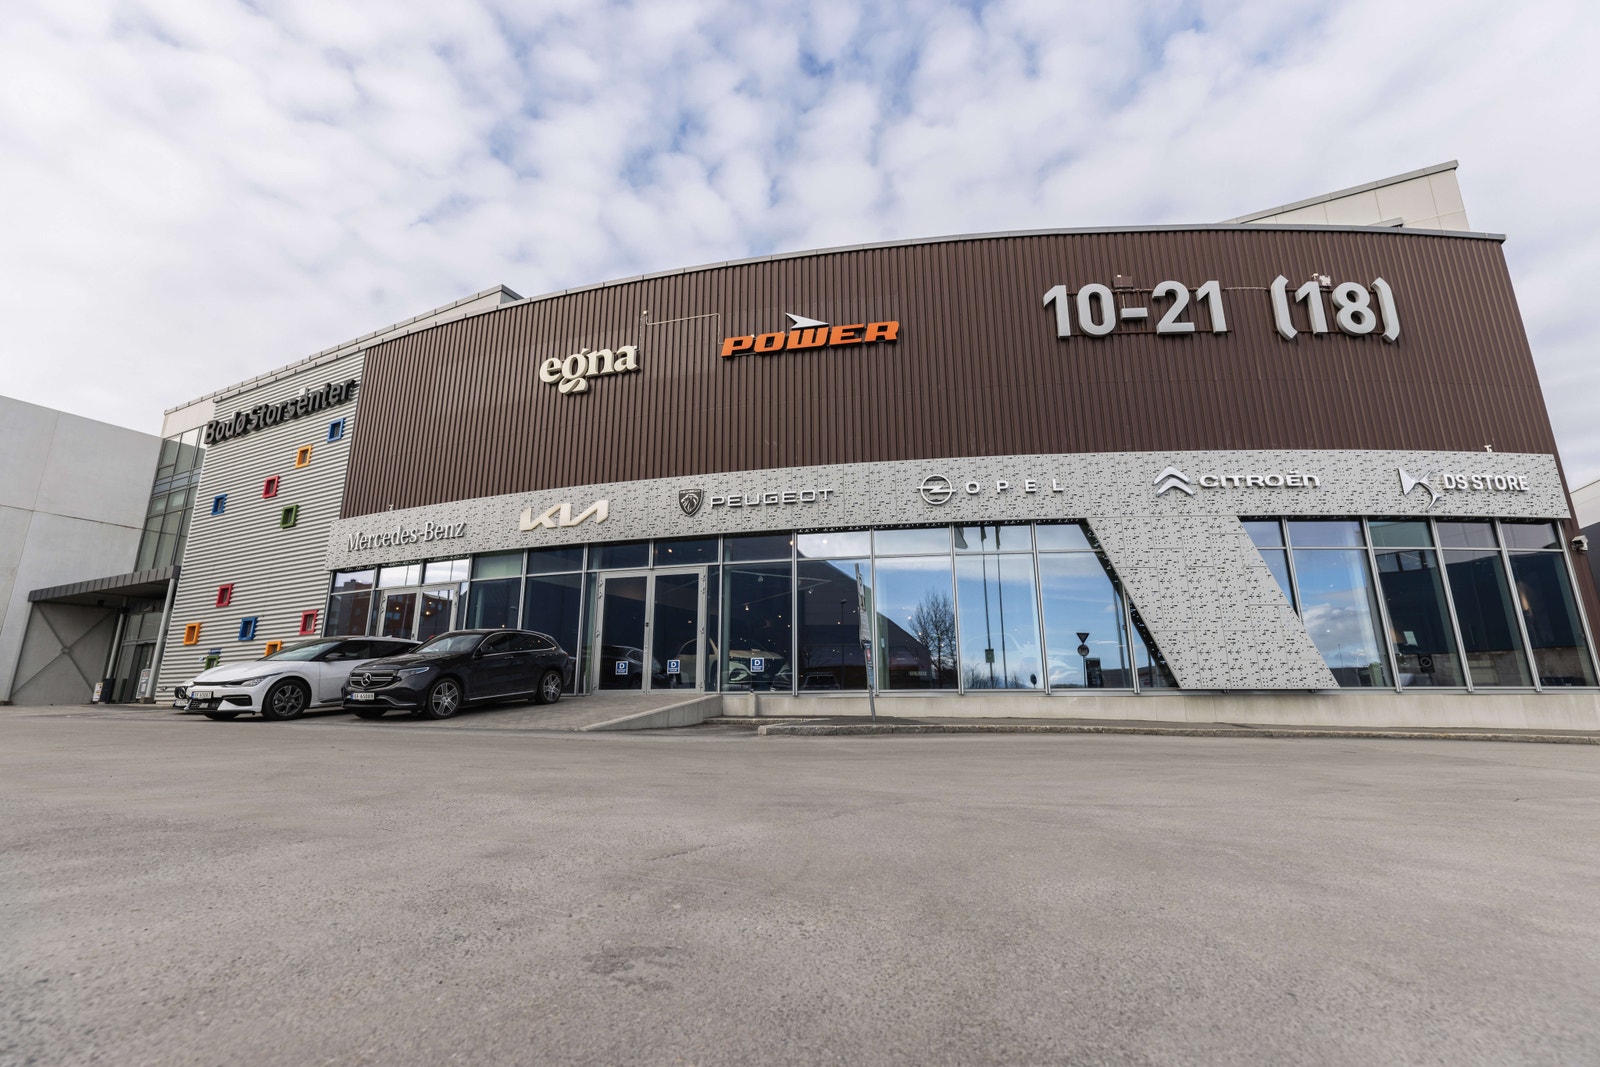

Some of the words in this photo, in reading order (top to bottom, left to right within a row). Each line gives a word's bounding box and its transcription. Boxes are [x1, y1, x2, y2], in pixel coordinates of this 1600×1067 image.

[1043, 280, 1228, 339] 10-21
[1270, 274, 1400, 343] (18)
[721, 320, 900, 358] POWER
[539, 345, 640, 395] egna
[204, 407, 247, 445] Bodø
[247, 379, 356, 432] Storsenter
[709, 488, 834, 508] PEUGEOT
[964, 478, 1065, 495] OPEL
[1443, 473, 1468, 490] DS
[1473, 475, 1530, 493] STORE
[519, 499, 609, 532] KIA
[347, 520, 467, 552] Mercedes-Benz
